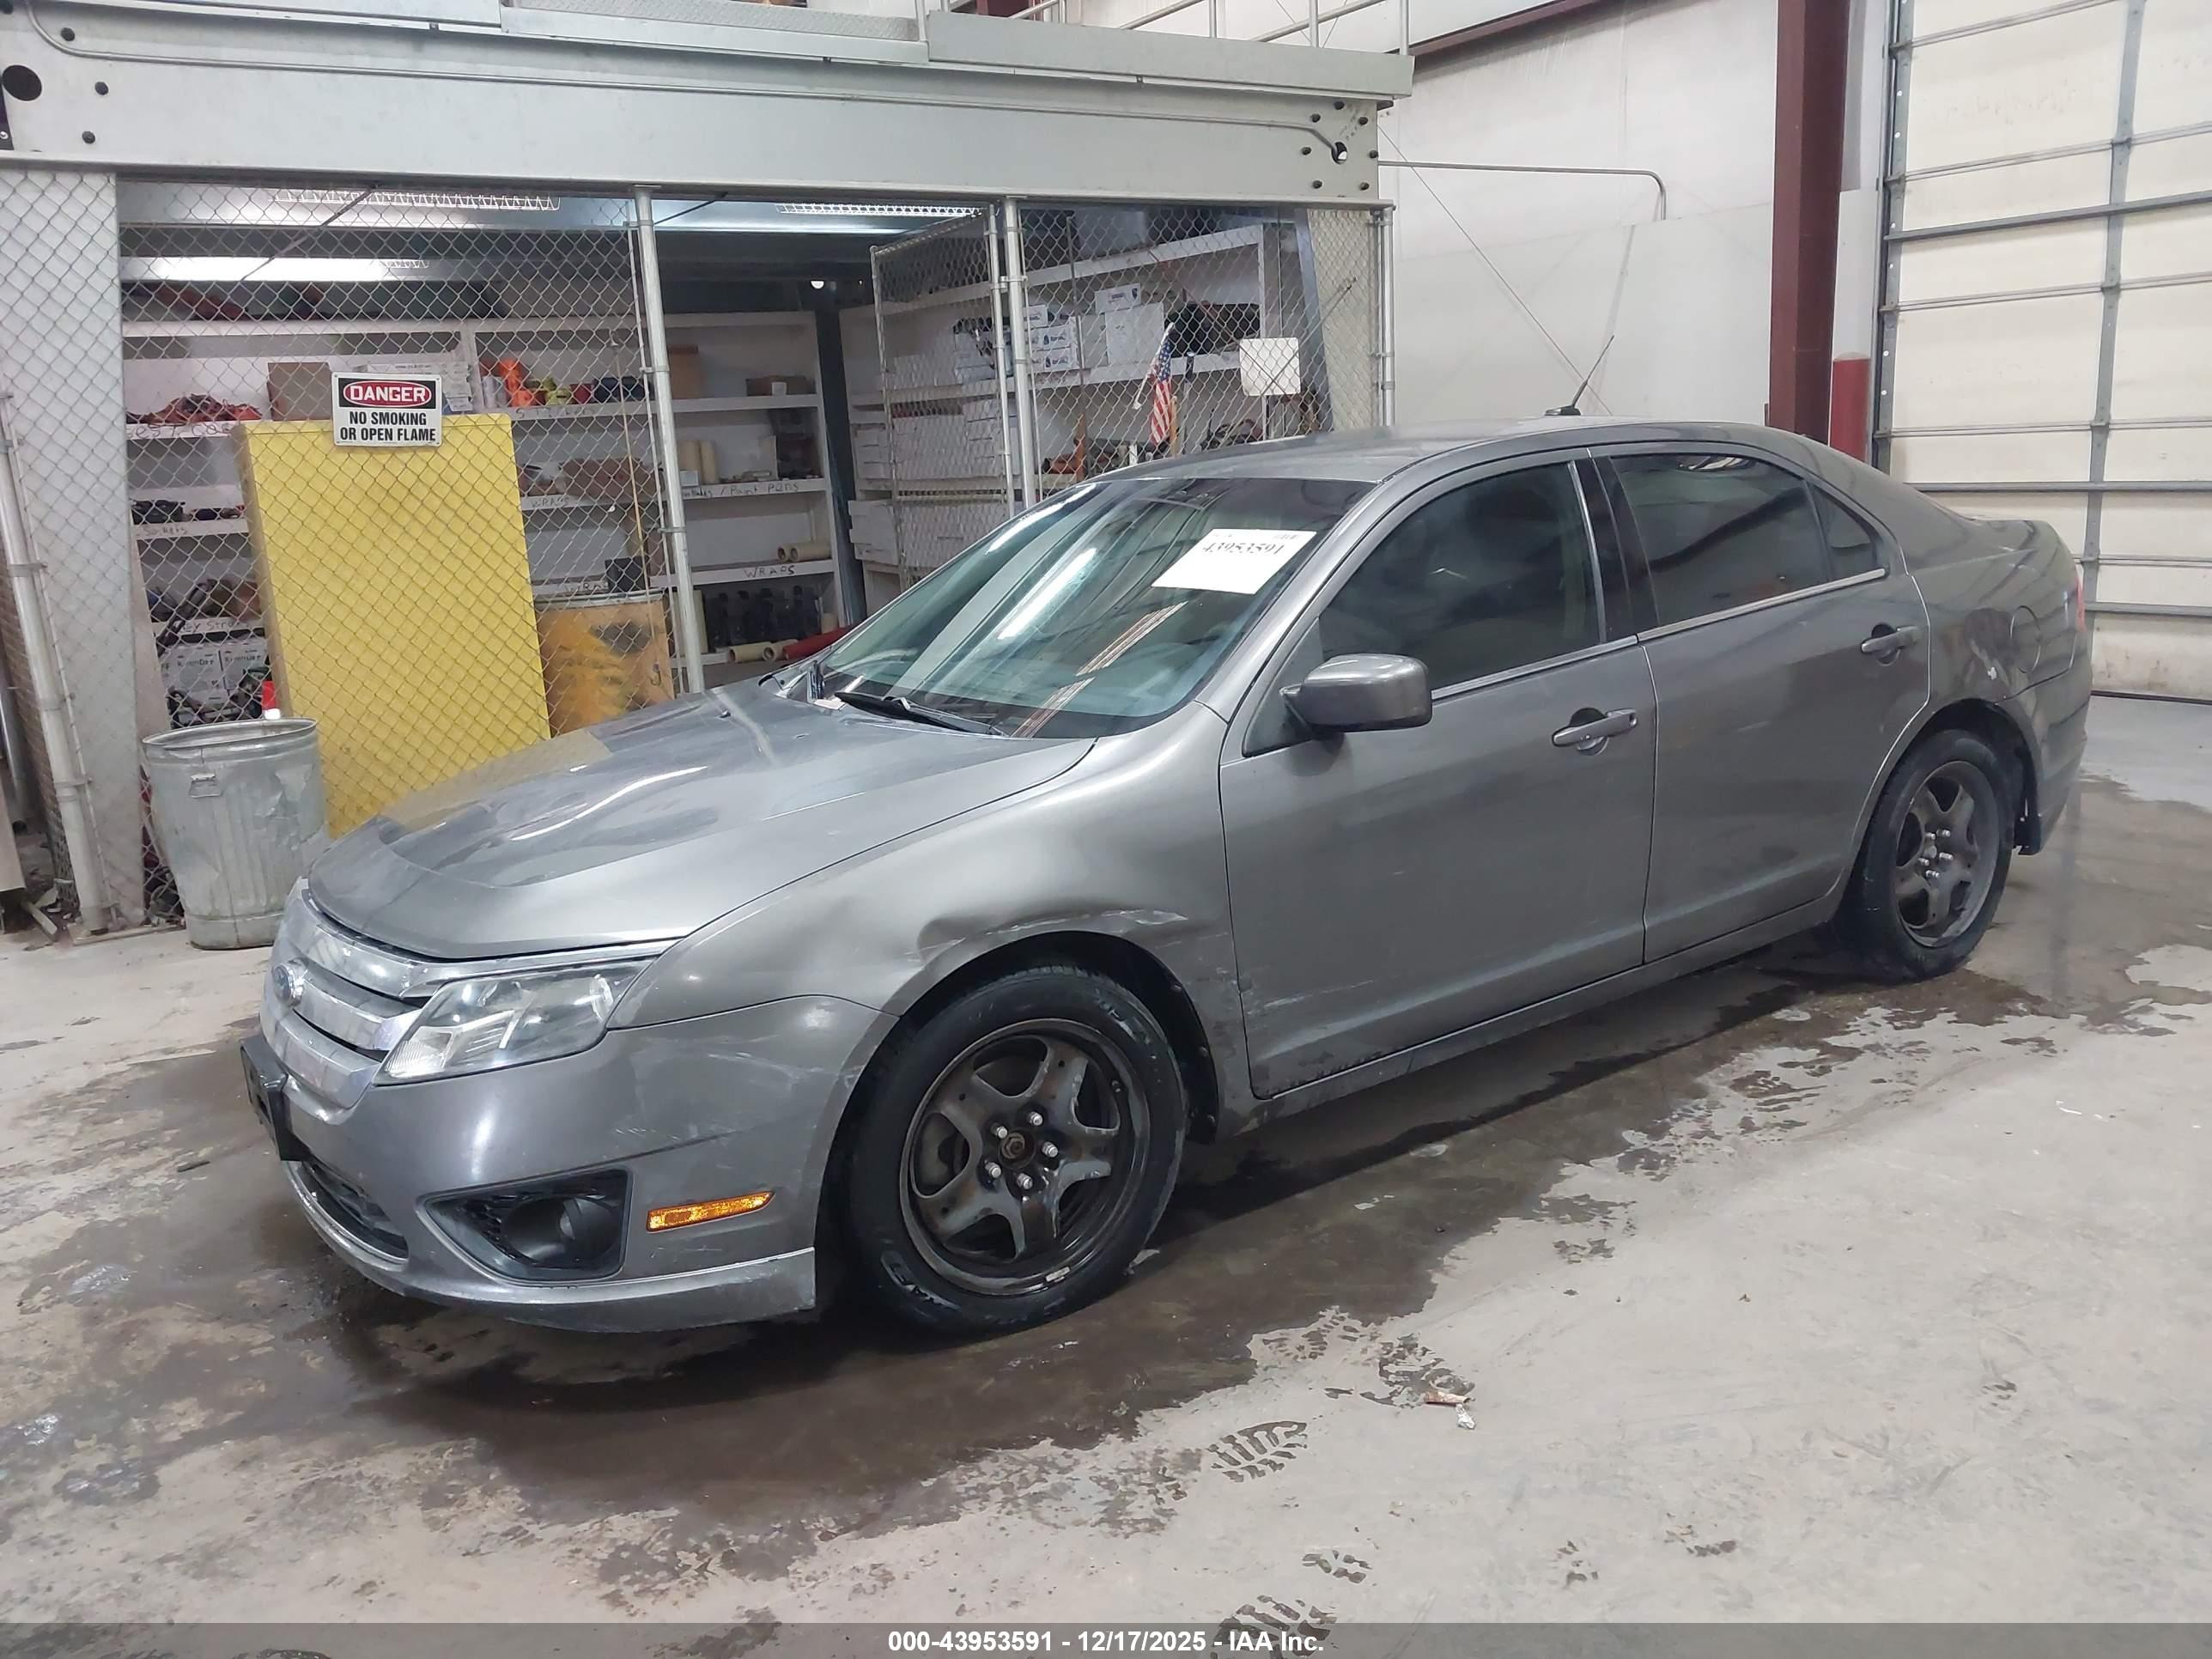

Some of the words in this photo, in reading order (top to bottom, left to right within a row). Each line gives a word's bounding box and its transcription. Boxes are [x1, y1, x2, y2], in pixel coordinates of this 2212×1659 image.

[349, 386, 426, 402] DANGER
[349, 410, 367, 425] NO
[371, 411, 427, 426] SMOKING
[340, 428, 356, 441] OR
[361, 428, 392, 441] OPEN
[398, 428, 435, 442] FLAME
